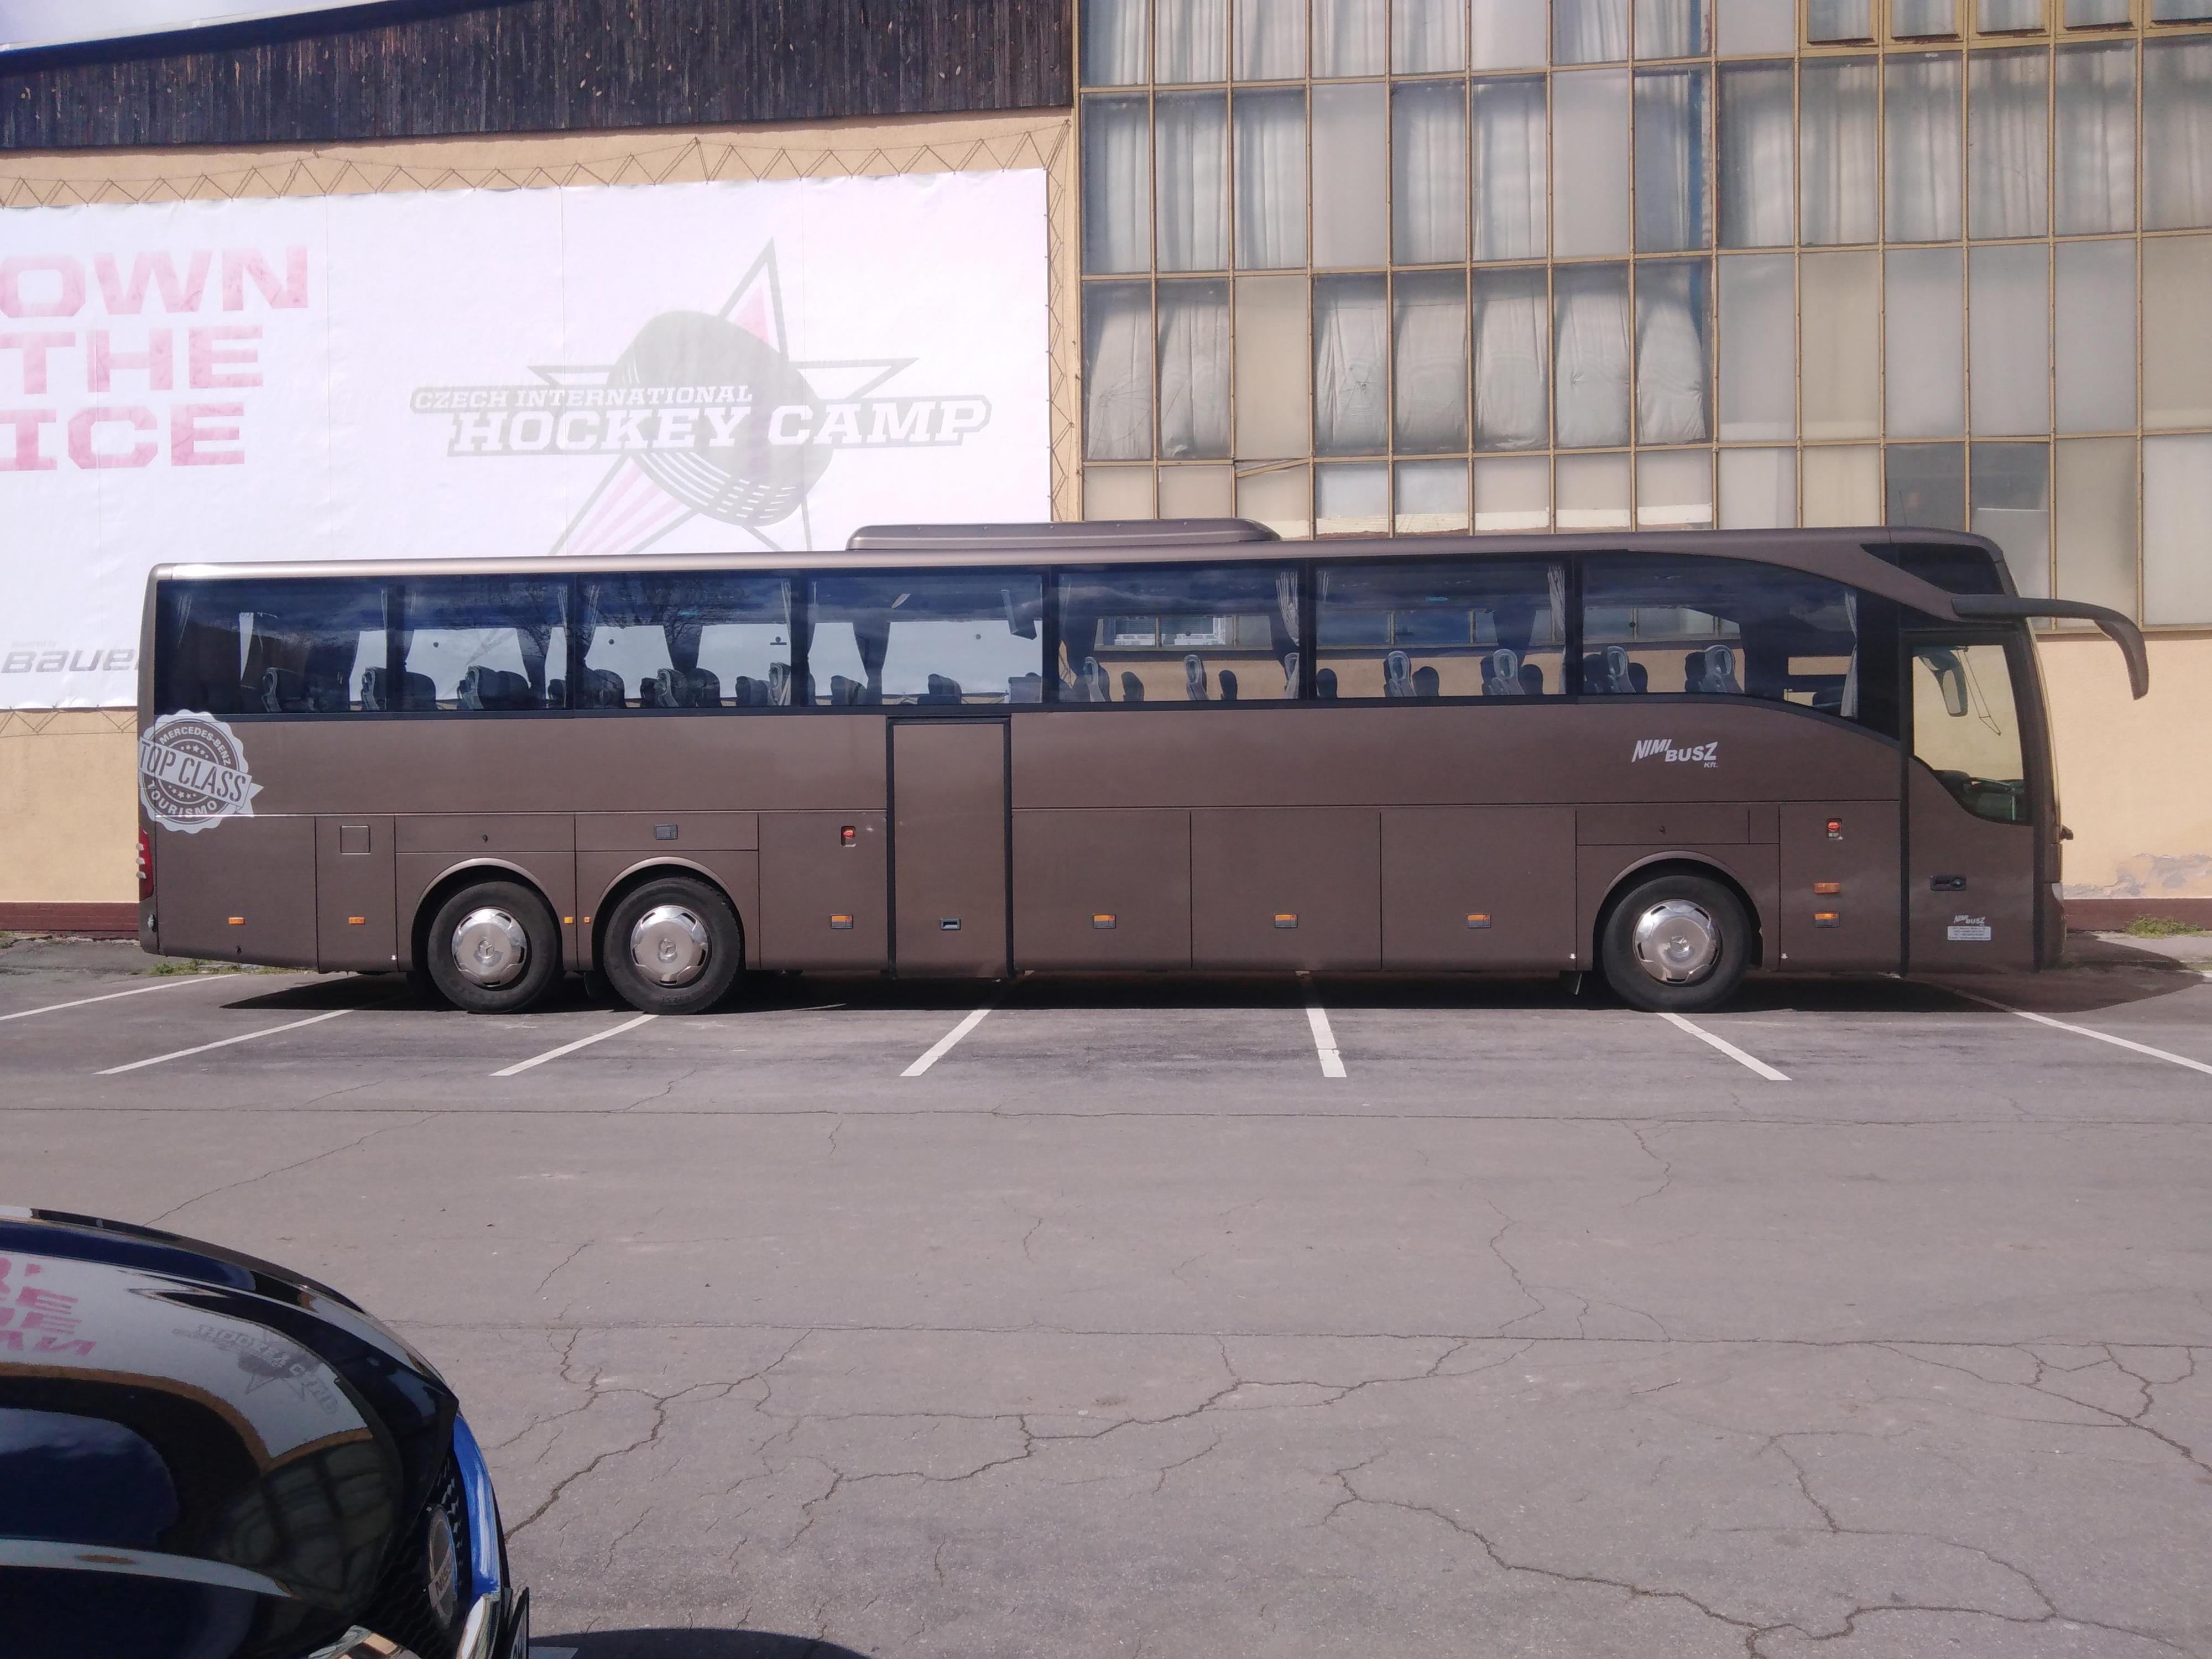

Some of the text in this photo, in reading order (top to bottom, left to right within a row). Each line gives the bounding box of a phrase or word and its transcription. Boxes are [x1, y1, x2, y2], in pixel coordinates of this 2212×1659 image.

[0, 245, 308, 318] OWN
[0, 325, 263, 394] THE
[414, 385, 753, 409] CZECH INTERNATIONAL
[0, 402, 244, 471] ICE
[452, 399, 989, 451] HOCKEY CAMP
[140, 741, 246, 802] TOP CLASS
[159, 726, 231, 766] MERCEDES-BENZ
[1631, 739, 1718, 763] NIMI BUSZ
[147, 780, 217, 817] TOURISMO
